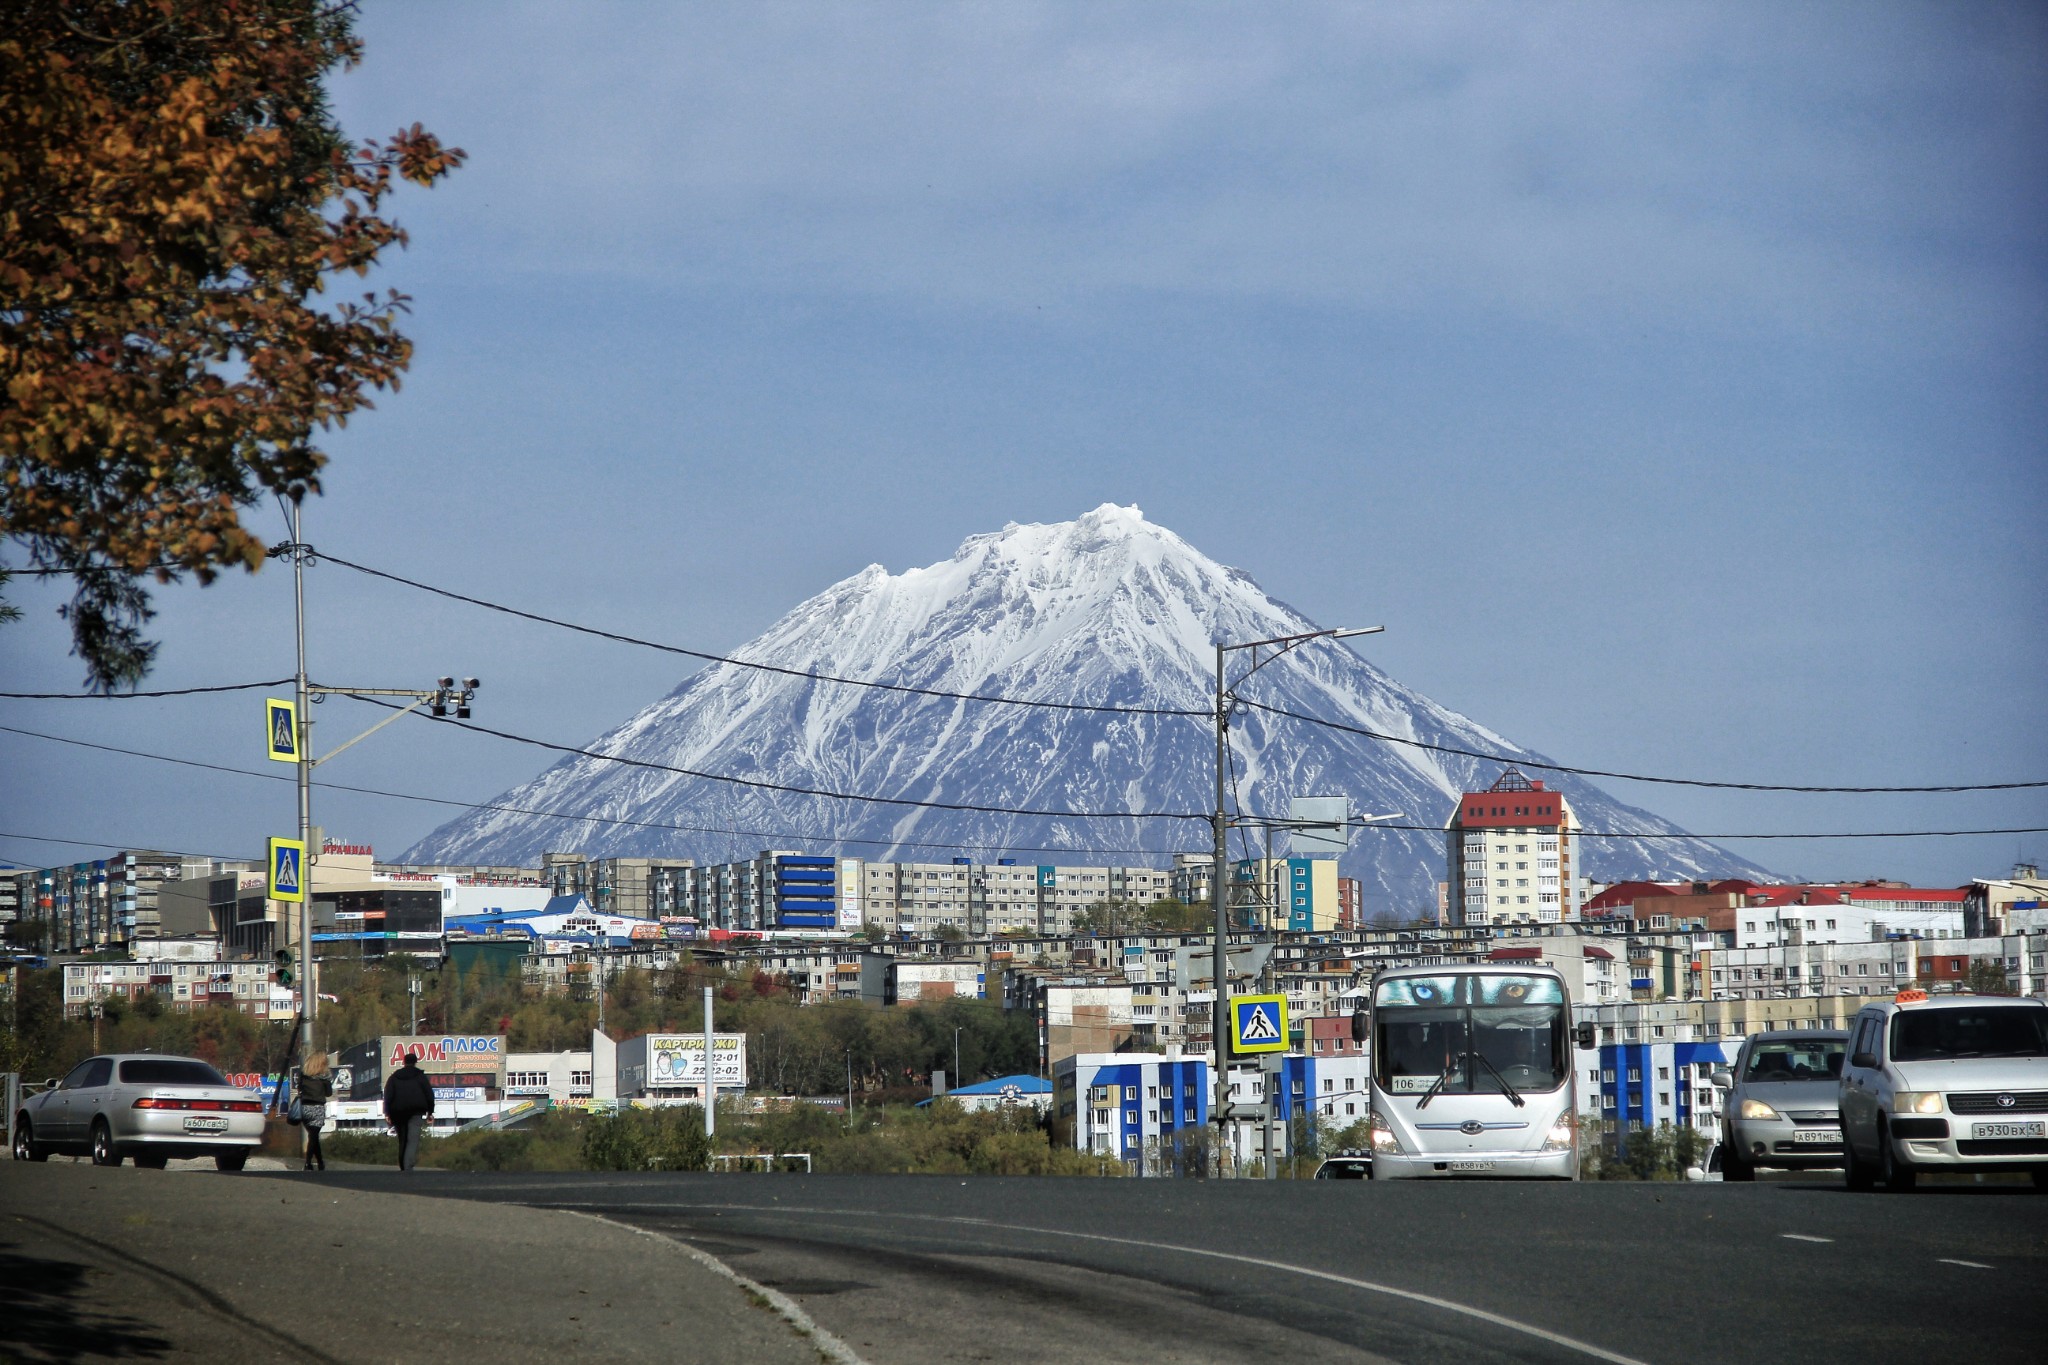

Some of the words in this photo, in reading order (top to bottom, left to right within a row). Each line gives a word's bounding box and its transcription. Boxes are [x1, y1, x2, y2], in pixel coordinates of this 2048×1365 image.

[322, 844, 373, 855] ИРАМИДА
[440, 1037, 499, 1054] ПЛЮС
[653, 1038, 738, 1051] КАРТРИЖИ
[1394, 1079, 1414, 1089] 106
[1978, 1124, 2026, 1136] В930ВХ
[2029, 1123, 2041, 1133] 41
[1798, 1132, 1836, 1141] А891МЕ
